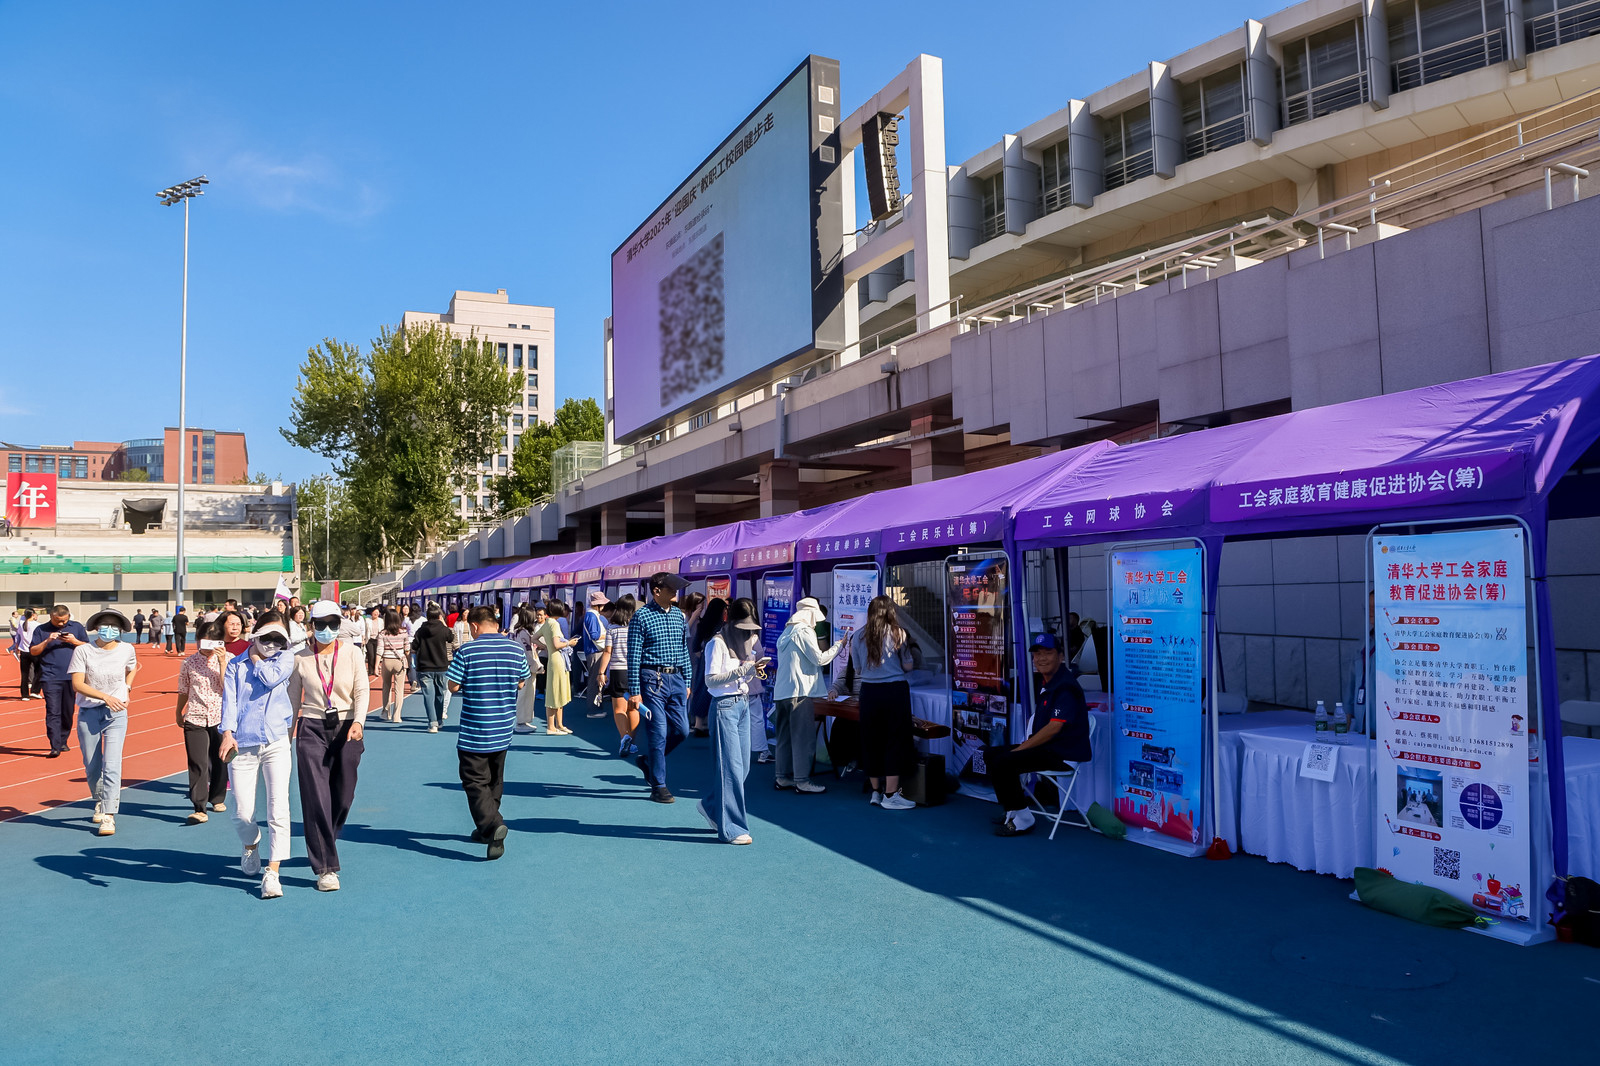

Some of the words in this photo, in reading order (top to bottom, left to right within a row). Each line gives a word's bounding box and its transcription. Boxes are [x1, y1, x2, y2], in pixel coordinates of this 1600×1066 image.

[1238, 466, 1484, 508] 工会家庭教育健康促进协会(筹)
[12, 482, 50, 518] 年
[1042, 500, 1174, 528] 工会网球协会
[808, 536, 870, 554] 工会太极拳协会
[1125, 570, 1187, 584] 清华大学工会
[1387, 560, 1507, 580] 清华大学工会家庭
[840, 583, 872, 593] 清华大学工会
[954, 575, 988, 586] 清华大学工会
[1390, 582, 1506, 601] 教育促进协会(筹)
[1403, 712, 1432, 722] 协会联系人
